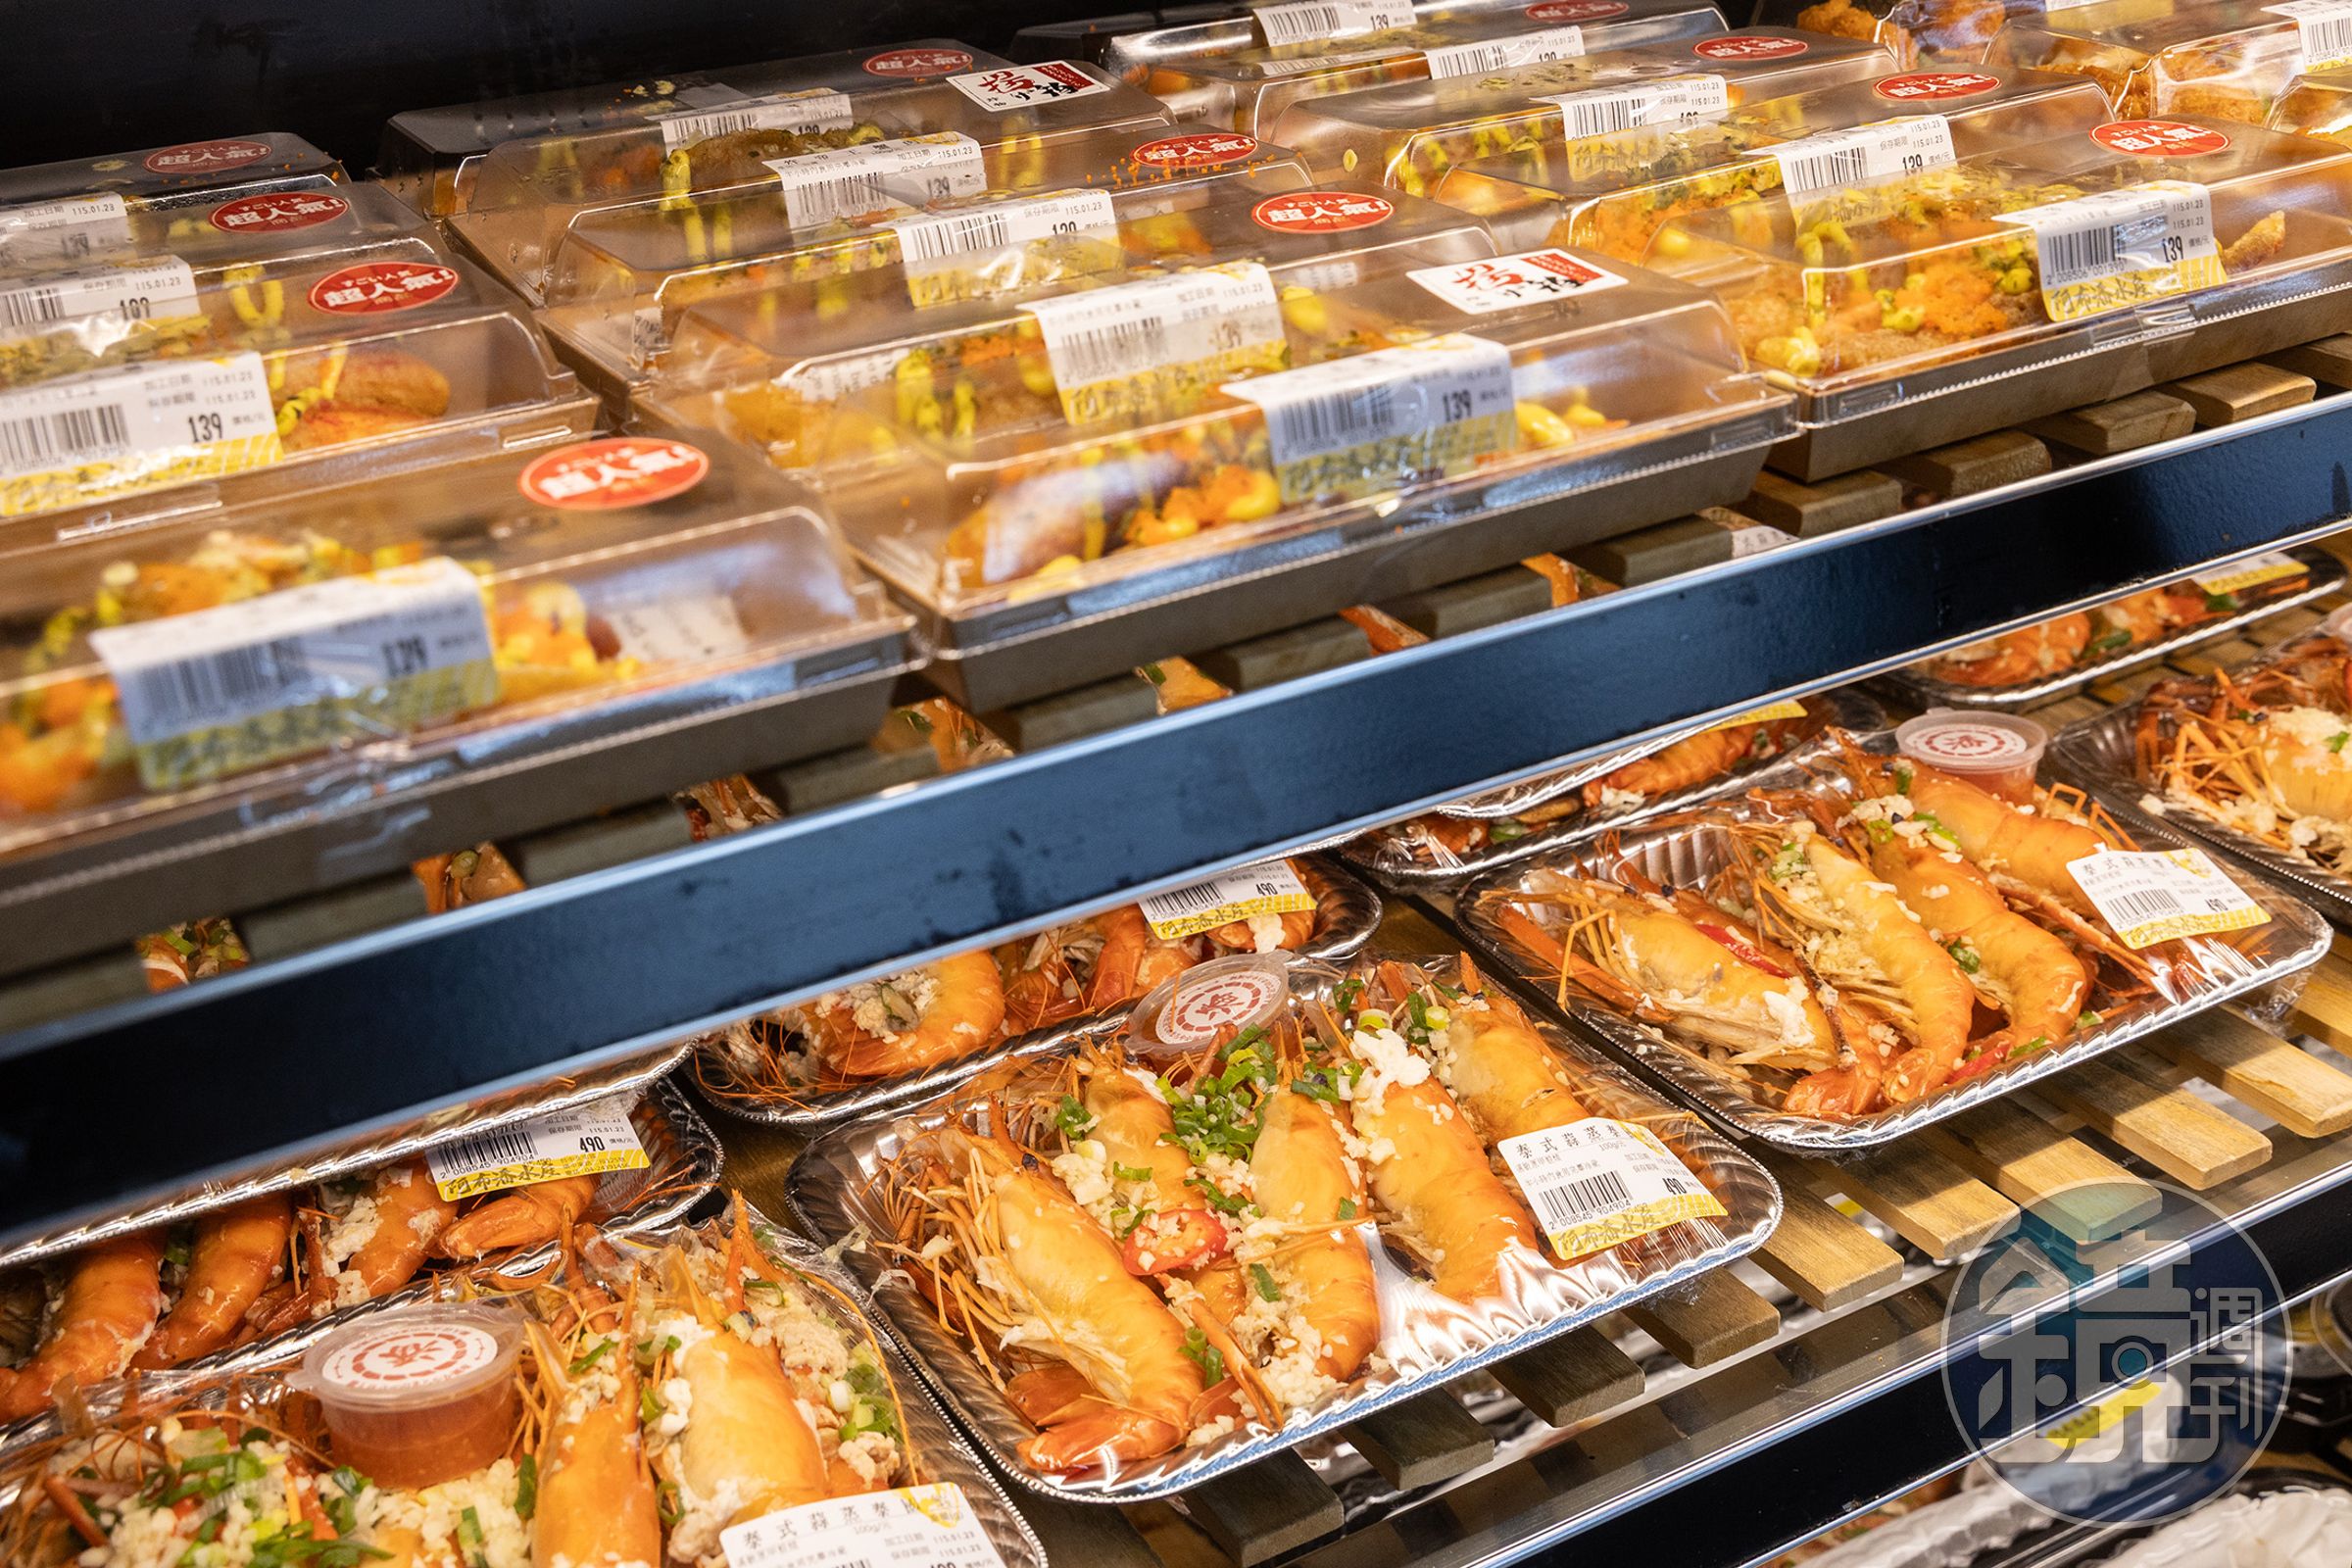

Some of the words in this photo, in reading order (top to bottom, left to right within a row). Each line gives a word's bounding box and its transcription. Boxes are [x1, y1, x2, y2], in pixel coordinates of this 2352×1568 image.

[1888, 74, 1991, 97] 超人氣!
[1913, 135, 1943, 149] 115.01.23
[2111, 126, 2211, 151] 超人氣!
[157, 147, 268, 166] 超人氣!
[72, 203, 116, 216] 115.01.23
[223, 199, 344, 226] 超人氣!
[1066, 202, 1103, 216] 115.01.23
[1267, 200, 1390, 222] 超人氣!
[2173, 199, 2204, 212] 115.01.23
[2173, 217, 2204, 229] 115.01.23
[2163, 236, 2184, 263] 139
[135, 276, 182, 291] 115.01.23
[323, 270, 454, 307] 超人氣!
[1441, 389, 1473, 422] 139
[188, 413, 223, 443] 139
[1255, 882, 1278, 896] 490
[579, 1136, 606, 1152] 490
[1662, 1177, 1688, 1195] 490
[1559, 1211, 1593, 1227] 008545
[1595, 1199, 1632, 1216] 904904
